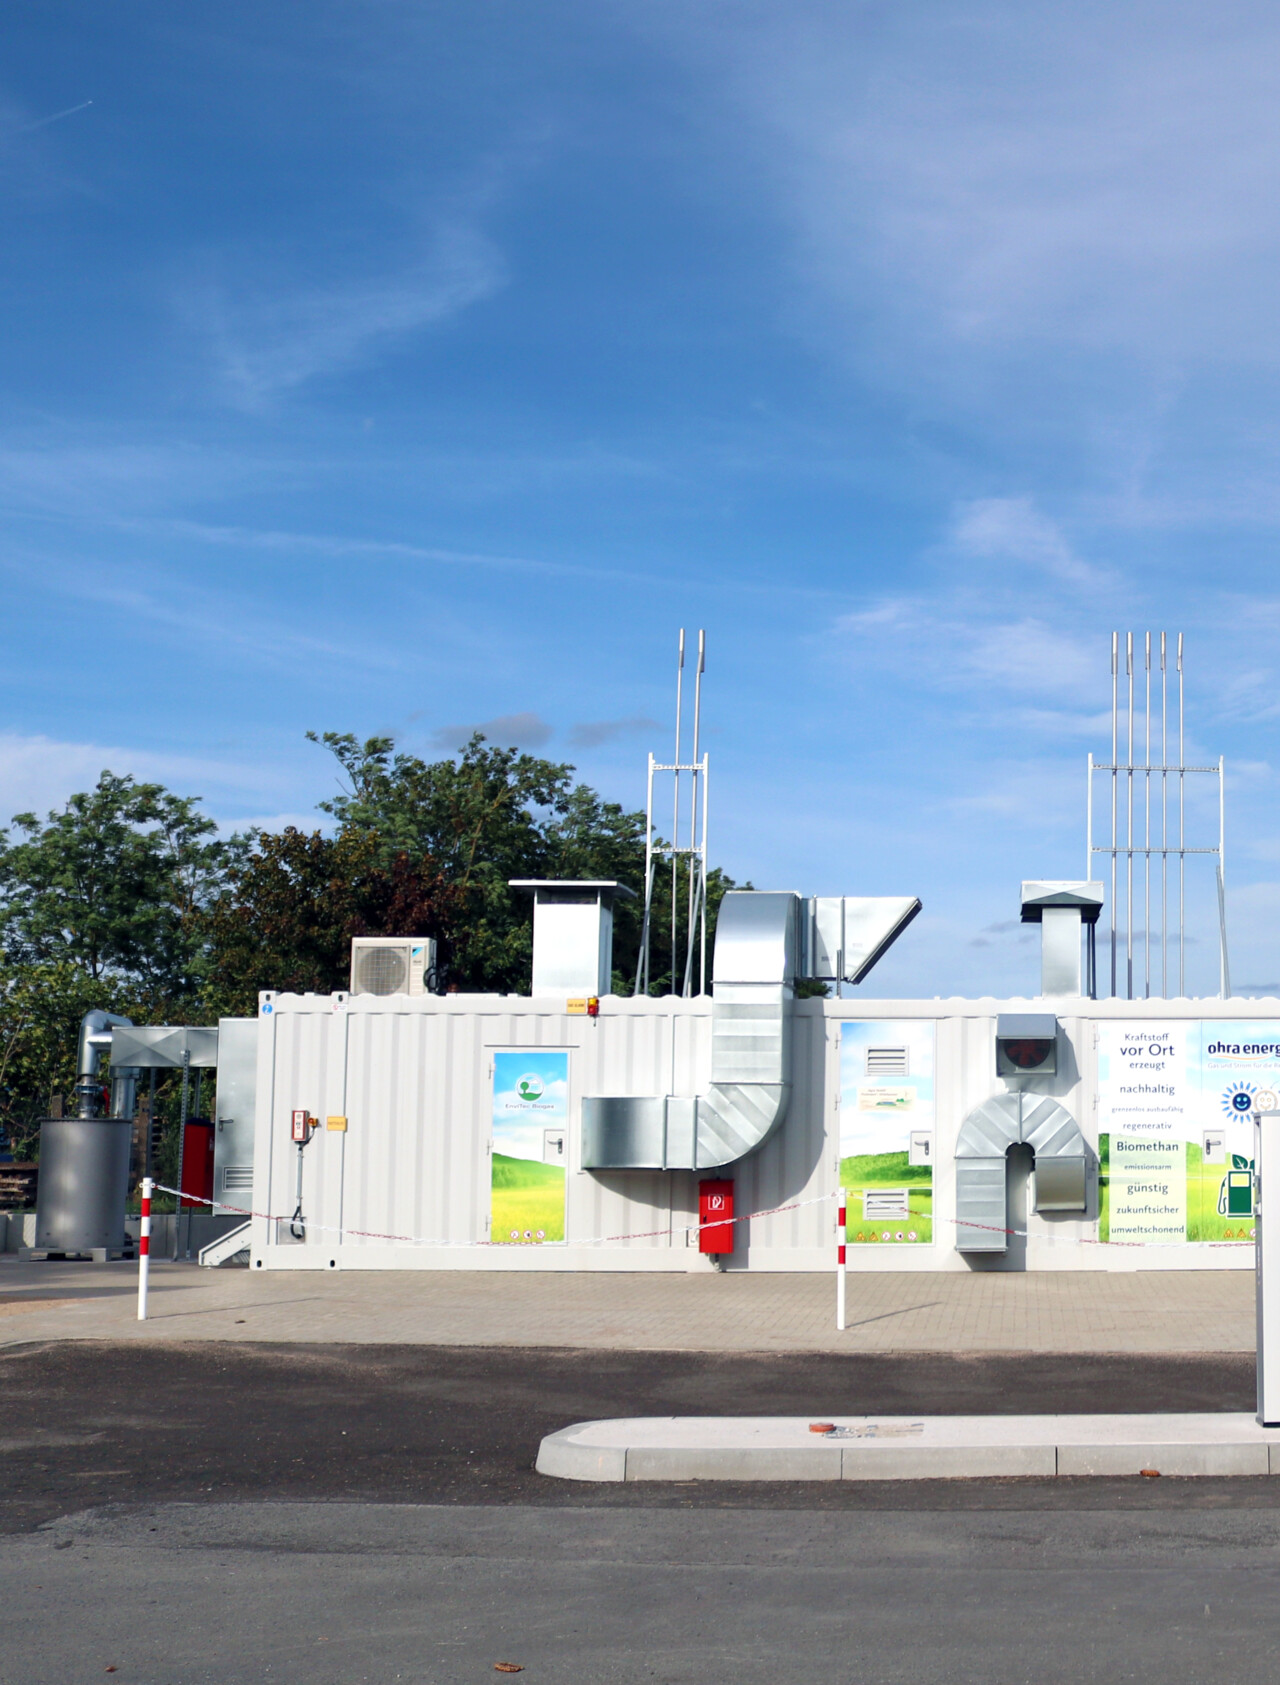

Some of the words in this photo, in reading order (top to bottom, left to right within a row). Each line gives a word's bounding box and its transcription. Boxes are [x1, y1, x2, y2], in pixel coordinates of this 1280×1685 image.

[1124, 1032, 1169, 1042] Kraftstoff
[1120, 1046, 1144, 1056] vor
[1148, 1043, 1175, 1056] Ort
[1207, 1041, 1241, 1055] ohra
[1129, 1061, 1166, 1070] erzeugt
[1119, 1083, 1176, 1096] nachhaltig
[1111, 1105, 1145, 1113] grenzenlos
[1122, 1121, 1172, 1131] regenerativ
[1116, 1140, 1179, 1152] Biomethan
[1124, 1162, 1172, 1171] emissionsarm
[1127, 1182, 1169, 1195] günstig
[1116, 1205, 1179, 1215] zukunftsicher
[1111, 1225, 1185, 1235] umweltschonend
